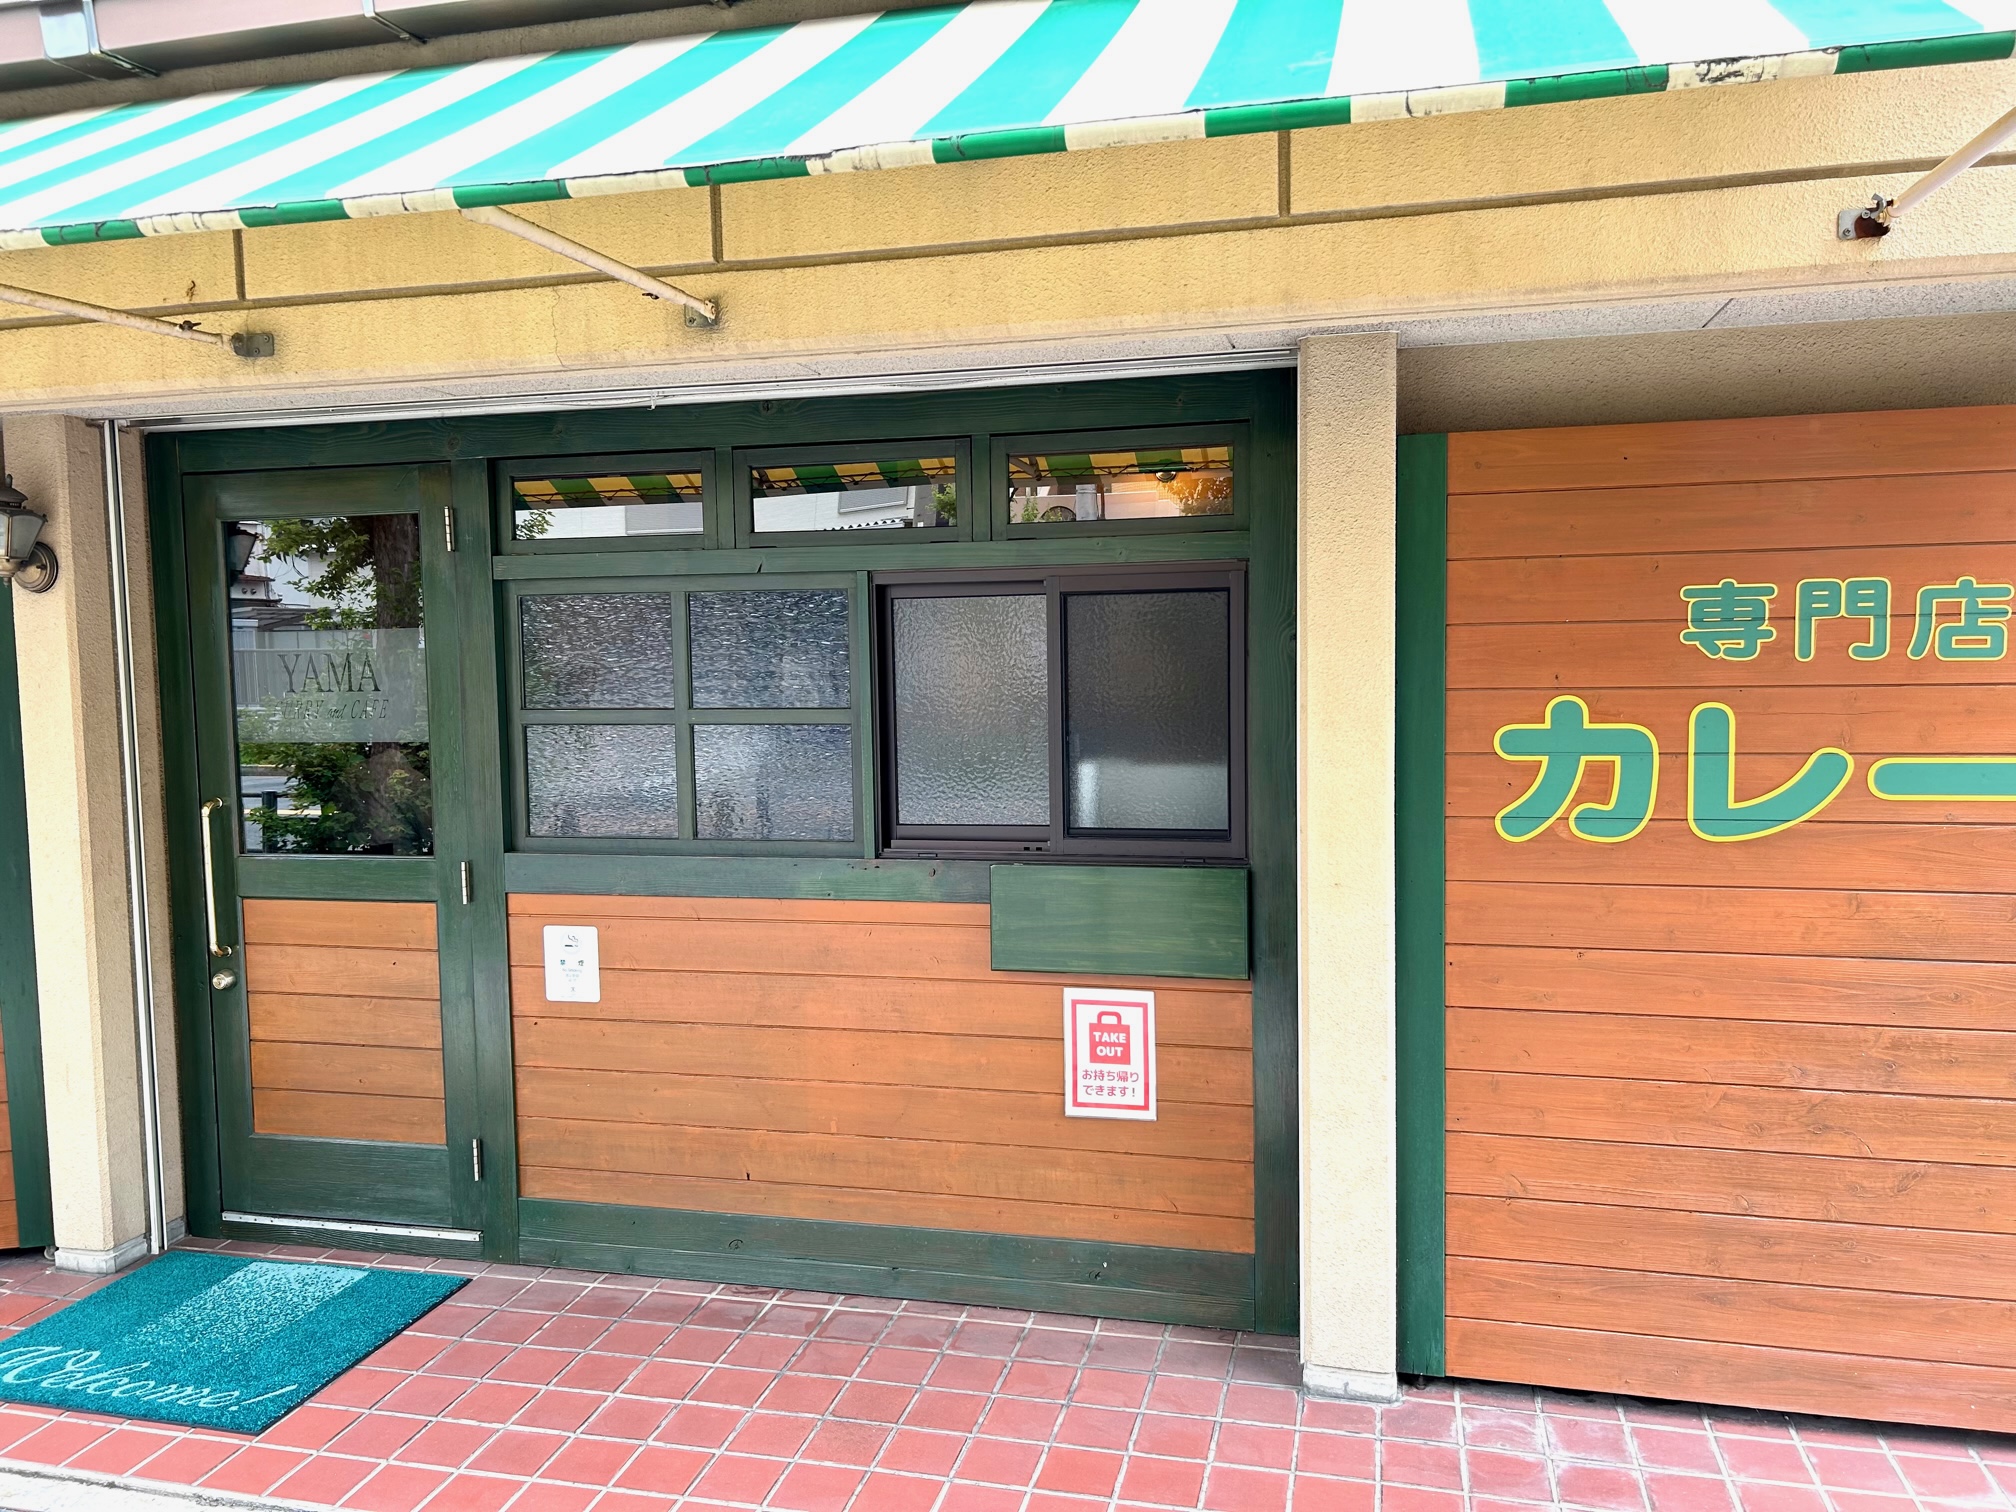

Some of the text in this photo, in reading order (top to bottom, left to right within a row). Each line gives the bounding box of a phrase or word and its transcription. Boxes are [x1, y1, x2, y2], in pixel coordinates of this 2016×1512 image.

[1679, 575, 2014, 661] 専門店
[277, 652, 381, 693] YAMA
[350, 699, 389, 719] CAFE
[1493, 694, 2016, 843] カレー
[1093, 1032, 1126, 1043] TAKE
[1096, 1046, 1123, 1057] OUT
[1082, 1069, 1139, 1083] お持ち帰り
